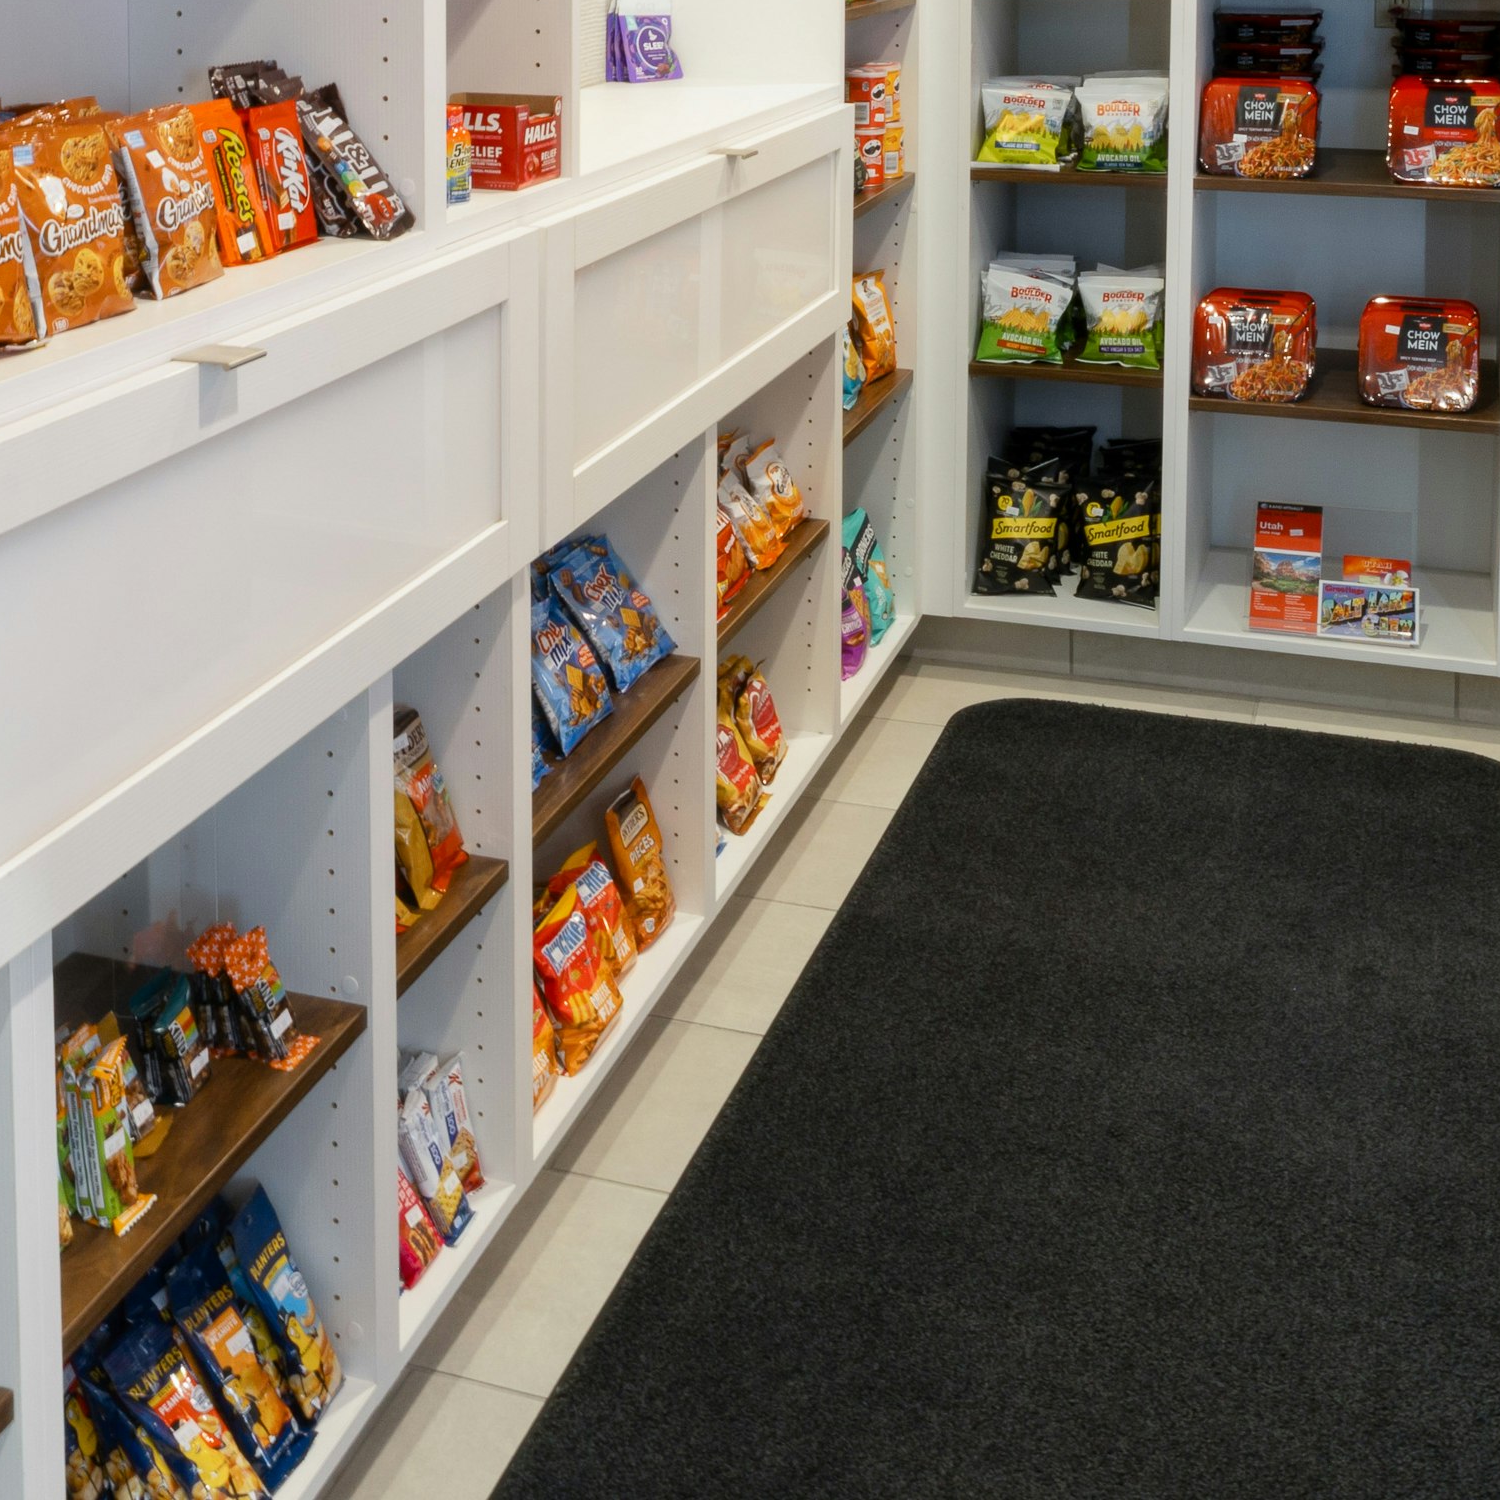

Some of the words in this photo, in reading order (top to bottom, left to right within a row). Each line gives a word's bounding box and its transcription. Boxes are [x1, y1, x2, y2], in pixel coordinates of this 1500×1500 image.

[1003, 95, 1046, 109] BOULDER
[1097, 102, 1141, 116] BOULDER
[1243, 101, 1275, 112] CHOW
[1244, 111, 1274, 121] MEIN
[1433, 104, 1469, 115] CHOW
[1434, 115, 1466, 125] MEIN
[1096, 153, 1126, 163] AVOCADO
[217, 127, 257, 223] Reese's
[61, 176, 105, 196] CHOCOLATE
[1011, 286, 1053, 303] BOULDER
[1102, 291, 1145, 303] BOULDER
[1235, 322, 1268, 333] CHOW
[1002, 331, 1031, 345] AVOCADO
[1031, 336, 1044, 347] OIL
[1099, 337, 1128, 346] AVOCADO
[1236, 332, 1265, 343] MEIN
[1407, 330, 1440, 341] CHOW
[1407, 340, 1439, 351] MEIN
[994, 518, 1054, 536] Smartfood
[1087, 521, 1145, 542] Smartfood
[1260, 521, 1283, 531] Utah
[994, 543, 1015, 554] WHITE
[989, 551, 1018, 563] CHEDDAR
[583, 563, 616, 603] Chex
[628, 833, 655, 867] PIECES
[254, 976, 276, 1011] KIND
[168, 1021, 188, 1057] KIND
[248, 1231, 286, 1282] PLANTERS
[183, 1284, 235, 1334] PLANTERS
[128, 1346, 183, 1400] PLANTERS
